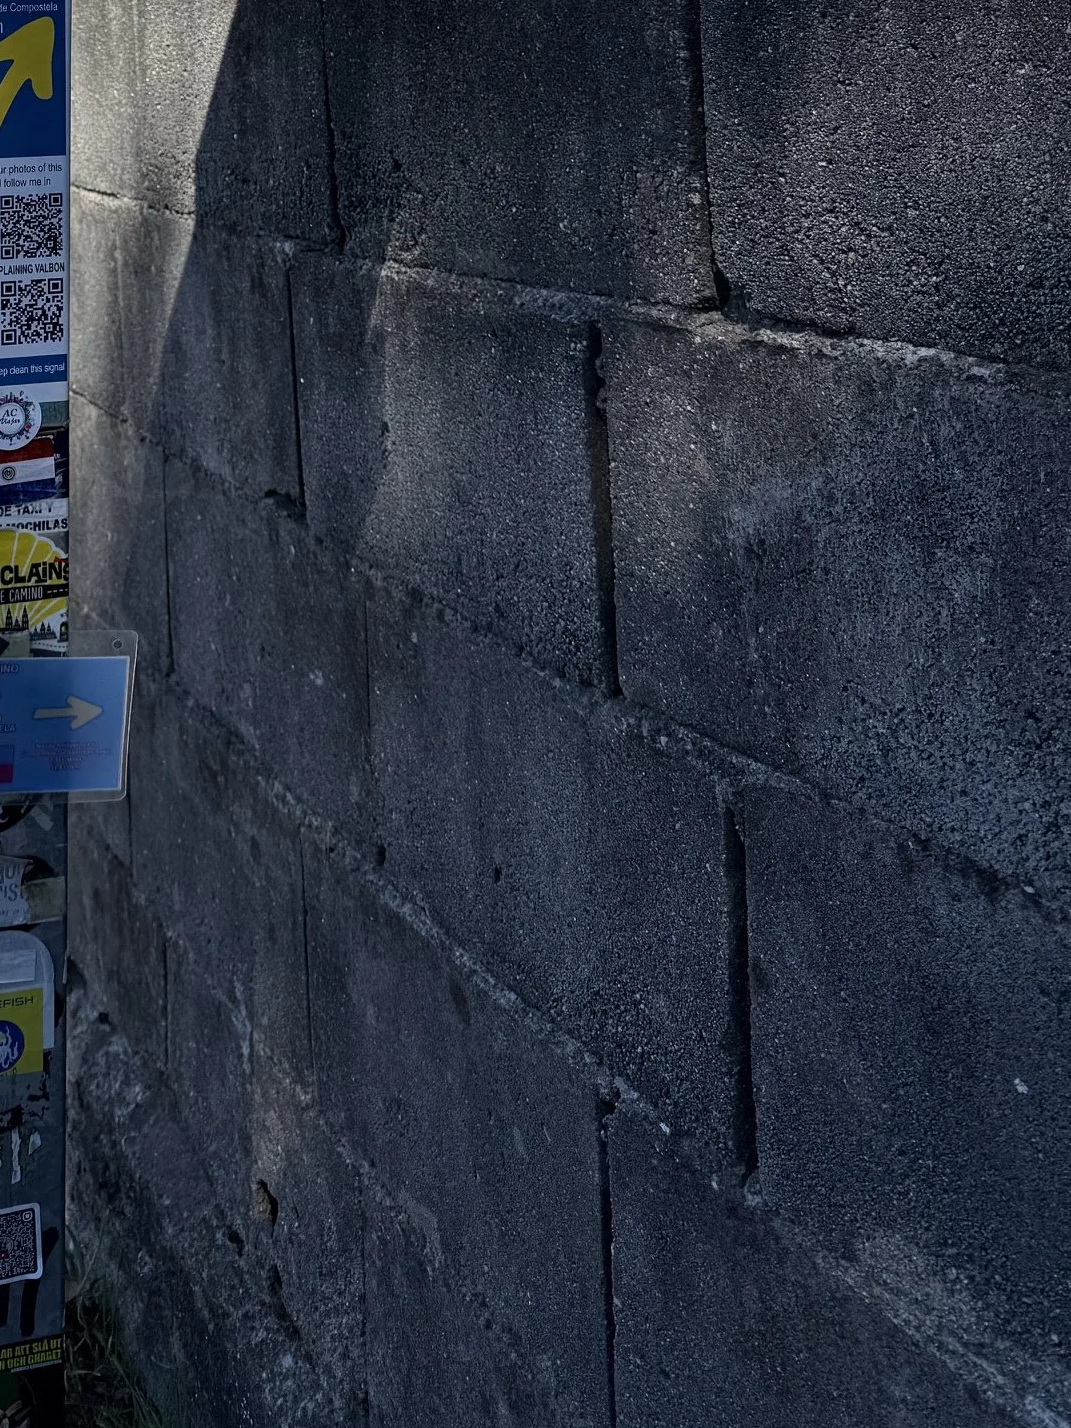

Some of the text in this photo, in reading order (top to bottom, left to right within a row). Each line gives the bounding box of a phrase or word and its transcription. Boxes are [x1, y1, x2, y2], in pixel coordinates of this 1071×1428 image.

[9, 2, 58, 13] Compostela
[8, 164, 35, 175] photos
[37, 162, 47, 172] of
[48, 162, 62, 172] this
[3, 178, 27, 188] follow
[29, 178, 42, 186] me
[44, 176, 51, 186] in
[10, 365, 29, 375] clean
[30, 364, 43, 373] this
[44, 362, 65, 374] signal
[2, 408, 18, 418] AC
[9, 586, 43, 602] CAMINO
[14, 1344, 31, 1356] ATT
[50, 1337, 62, 1349] UT
[7, 1356, 26, 1369] OCH
